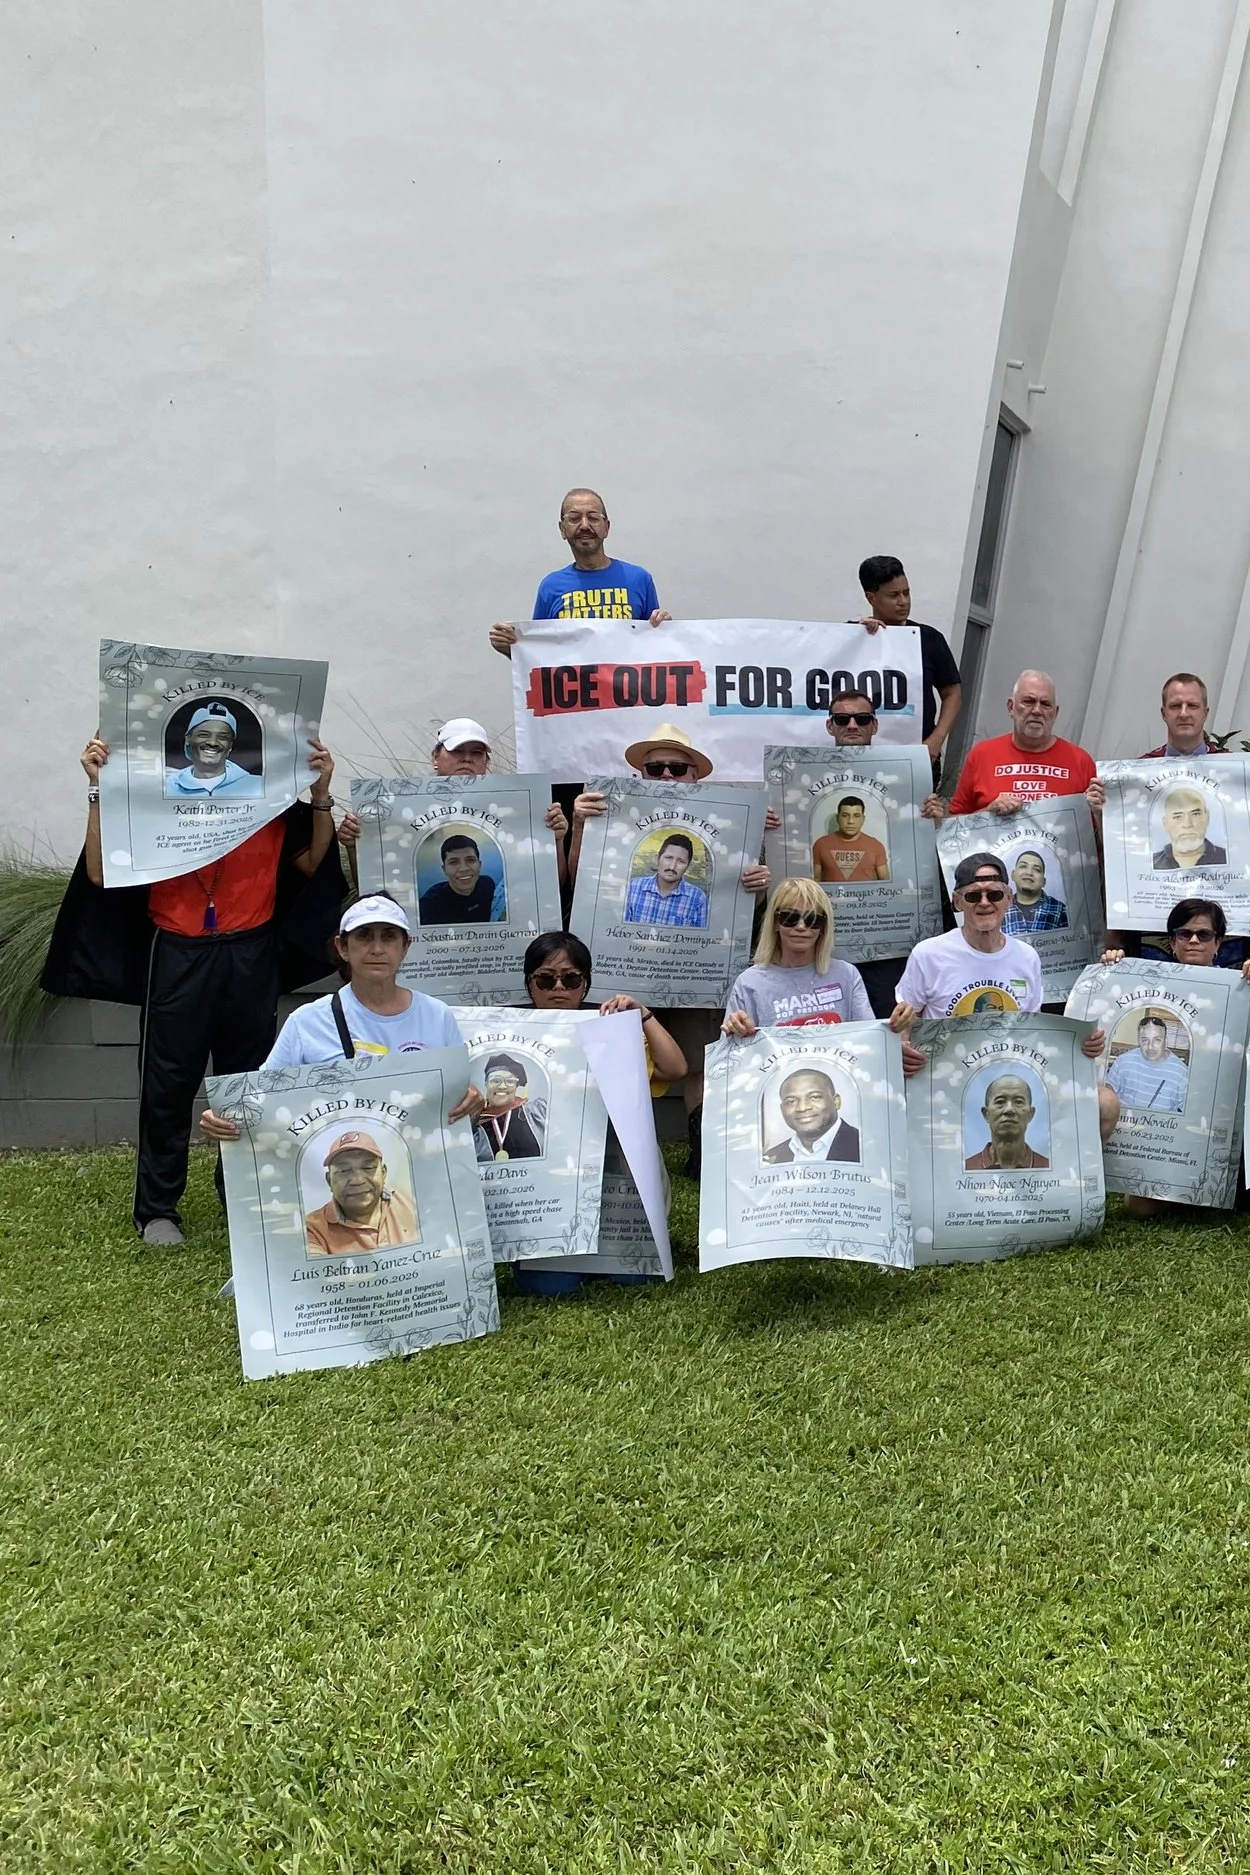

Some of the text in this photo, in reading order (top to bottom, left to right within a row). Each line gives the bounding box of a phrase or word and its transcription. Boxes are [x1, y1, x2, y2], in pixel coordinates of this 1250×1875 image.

[561, 588, 628, 609] TRUTH
[558, 604, 633, 619] MATTERS
[162, 680, 266, 702] KILLED BY ICE
[541, 665, 908, 711] ICE OUT FOR GOOD
[996, 765, 1068, 778] DO JUSTICE
[1145, 770, 1221, 792] KILLED BY ICE
[808, 775, 889, 796] KILLED BY ICE
[1014, 782, 1046, 790] LOVE
[173, 803, 257, 815] Keith Porter Jr.
[410, 806, 502, 832] KILLED BY ICE
[635, 811, 720, 839] KILLED BY ICE
[835, 851, 861, 862] GUESS
[946, 980, 1004, 1016] GOOD TROUBLE
[1116, 990, 1199, 1019] KILLED BY ICE
[776, 1003, 836, 1019] FOR FREEDOM
[468, 1034, 556, 1058] LLED BY ICE
[961, 1044, 1049, 1069] KILLED BY ICE
[758, 1046, 858, 1073] KILLED BY ICE
[286, 1098, 410, 1136] KILLED BY ICE
[1141, 1114, 1178, 1130] Noviello
[496, 1166, 528, 1180] Davis
[749, 1166, 872, 1188] Jean Wilson Brutus
[956, 1175, 1060, 1194] Nhon Ngoc Nguyen
[291, 1250, 442, 1282] Luis Beltran Yanez-Cruz
[320, 1282, 346, 1294] 1958
[358, 1270, 419, 1288] 01.06.2026
[294, 1304, 304, 1312] 68
[306, 1300, 327, 1311] years
[330, 1298, 344, 1306] old,
[346, 1294, 384, 1304] Honduras,
[386, 1290, 403, 1298] held
[414, 1280, 446, 1294] Imperial
